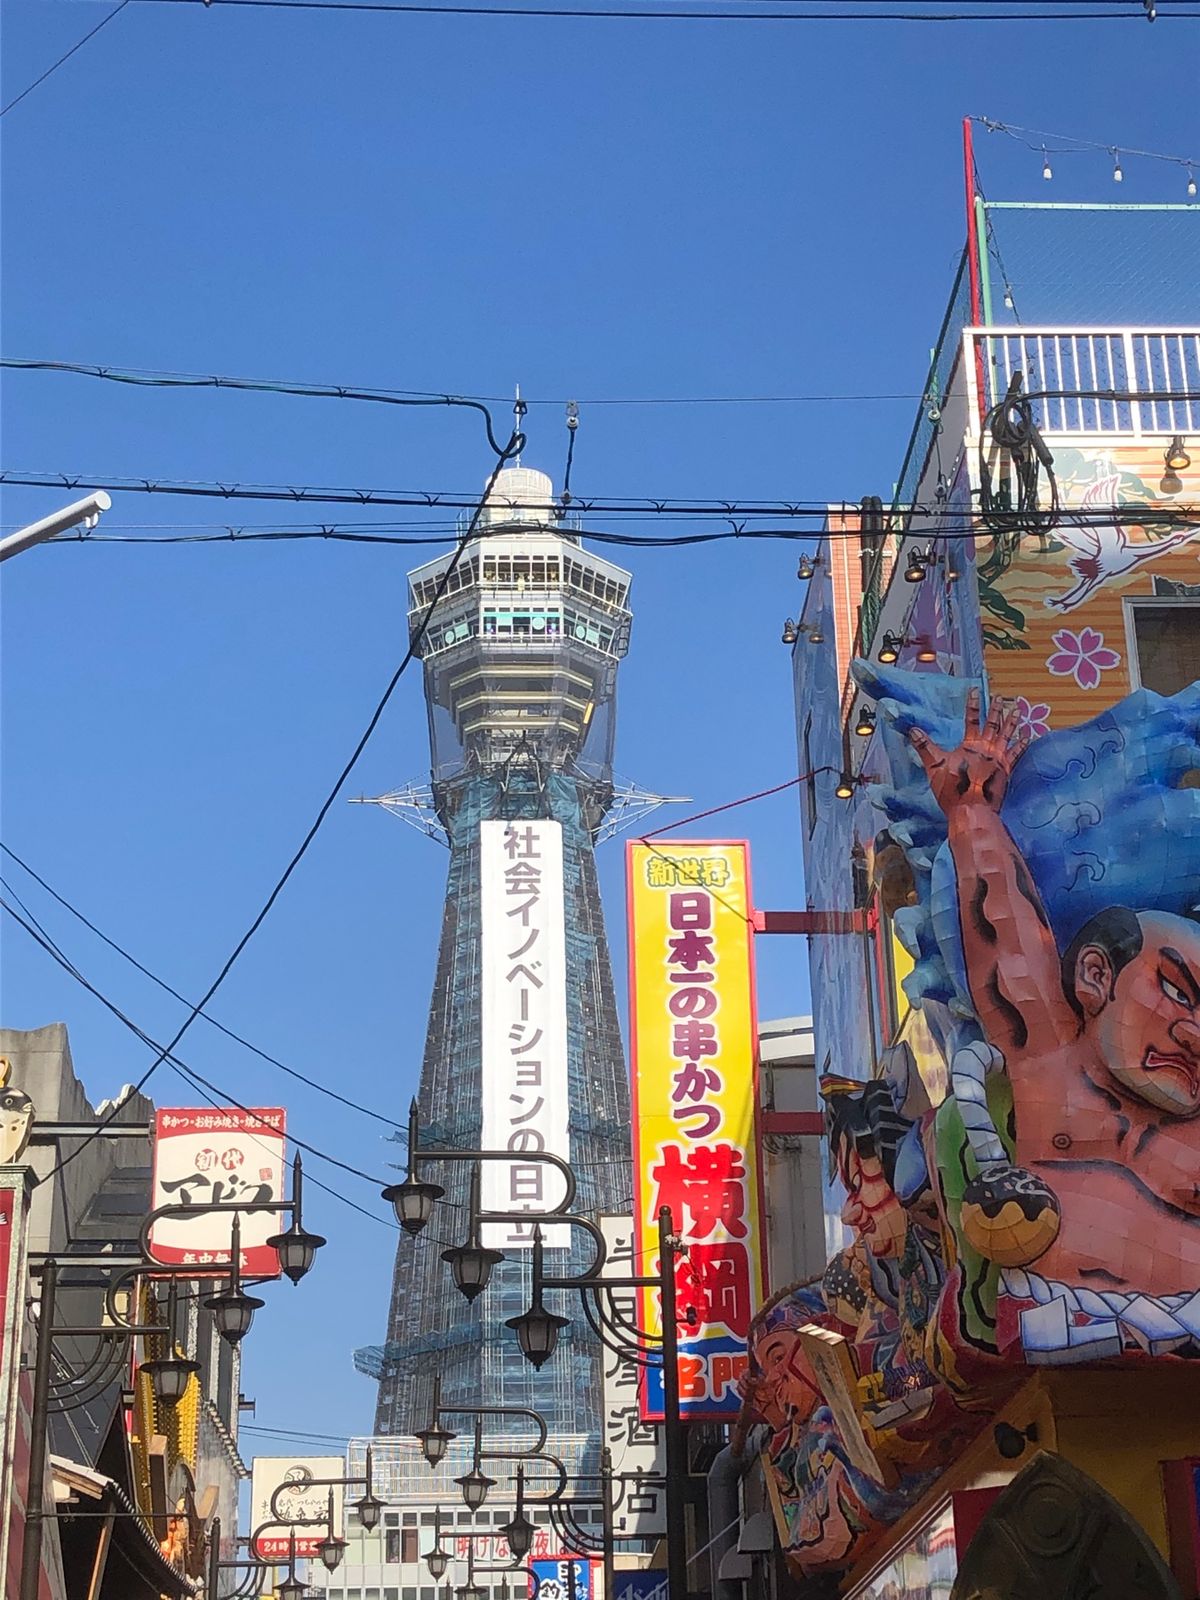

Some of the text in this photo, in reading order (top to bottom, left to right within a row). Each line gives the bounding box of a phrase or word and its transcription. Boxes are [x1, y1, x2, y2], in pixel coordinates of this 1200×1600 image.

[647, 857, 730, 887] 新世界
[503, 826, 547, 1241] 社会イノベーションの日立
[667, 891, 721, 1139] 日本一の串かつ
[652, 1143, 752, 1338] 横綱
